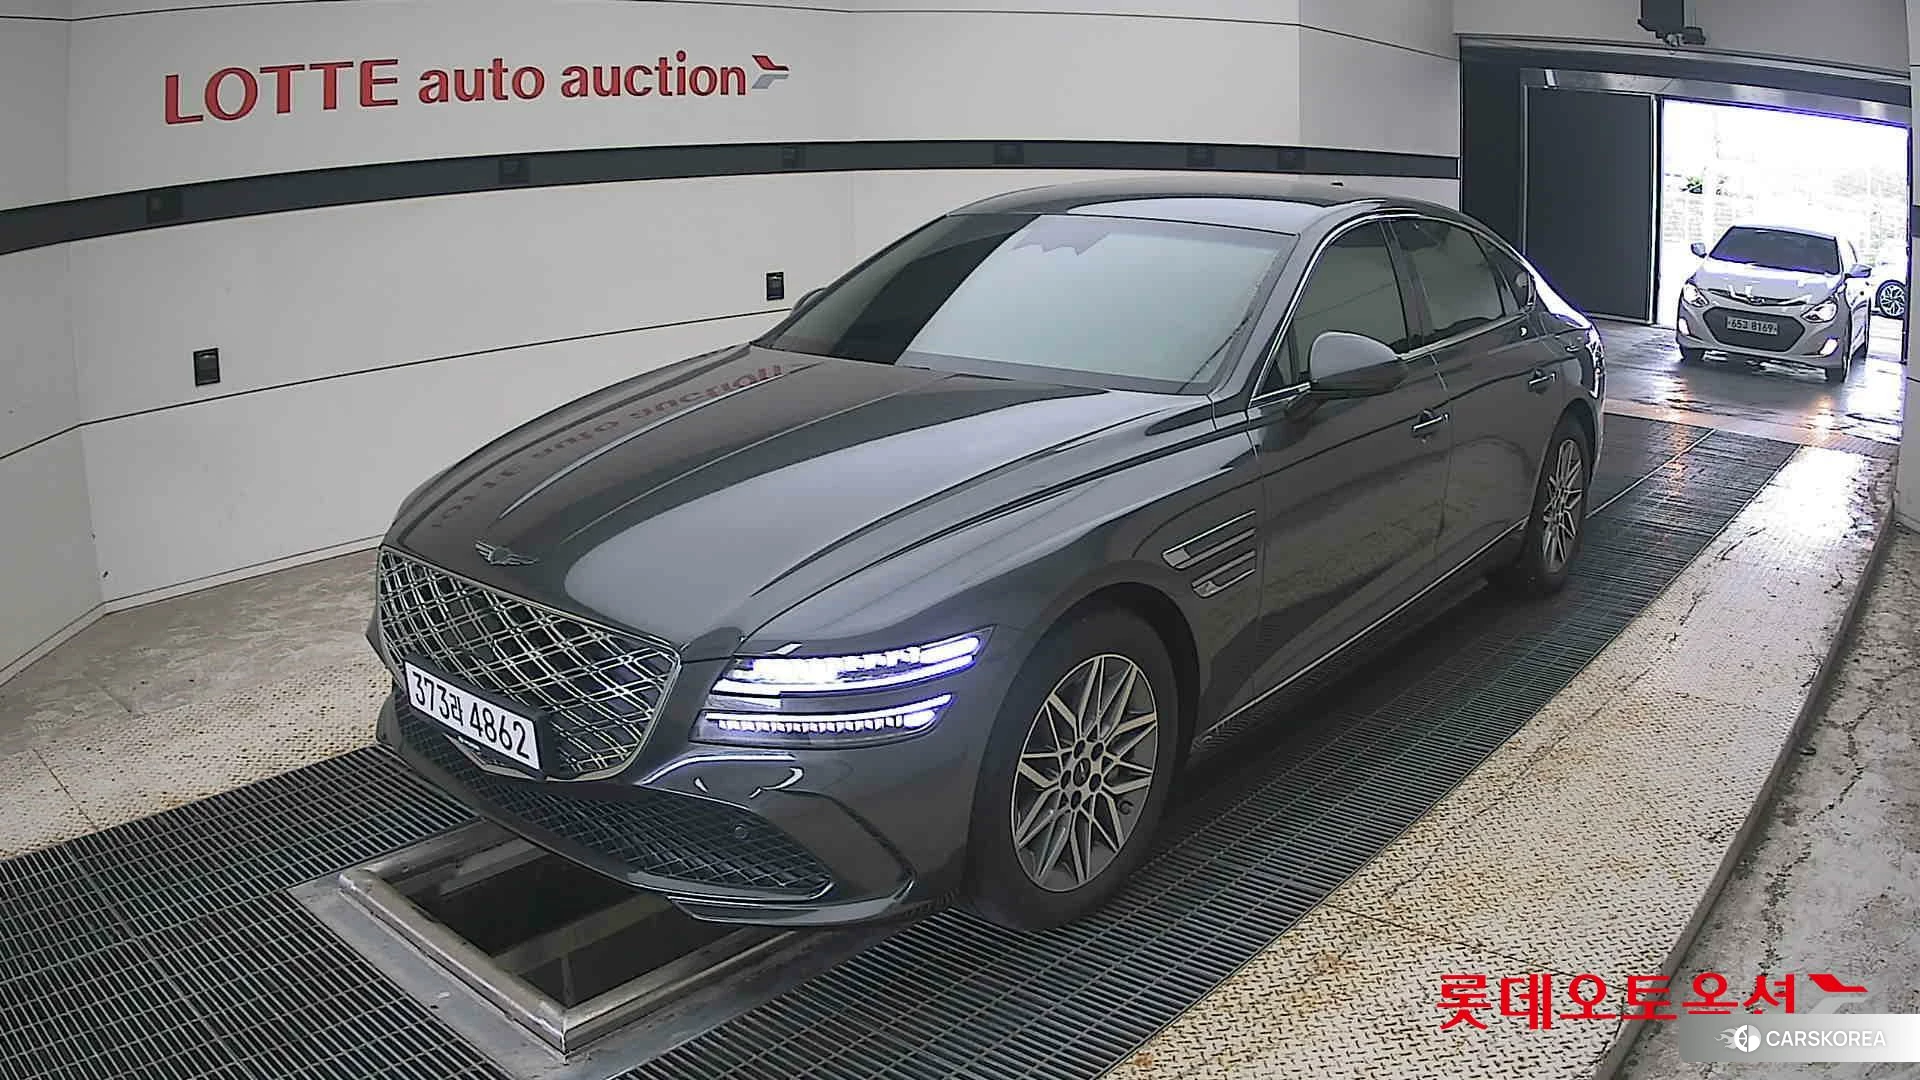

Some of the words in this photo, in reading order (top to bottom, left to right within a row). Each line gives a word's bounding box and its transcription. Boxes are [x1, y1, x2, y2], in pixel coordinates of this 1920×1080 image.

[163, 58, 399, 125] LOTTE
[418, 57, 546, 104] auto
[561, 50, 748, 98] auction
[412, 671, 464, 727] 373라
[469, 702, 530, 760] 4862
